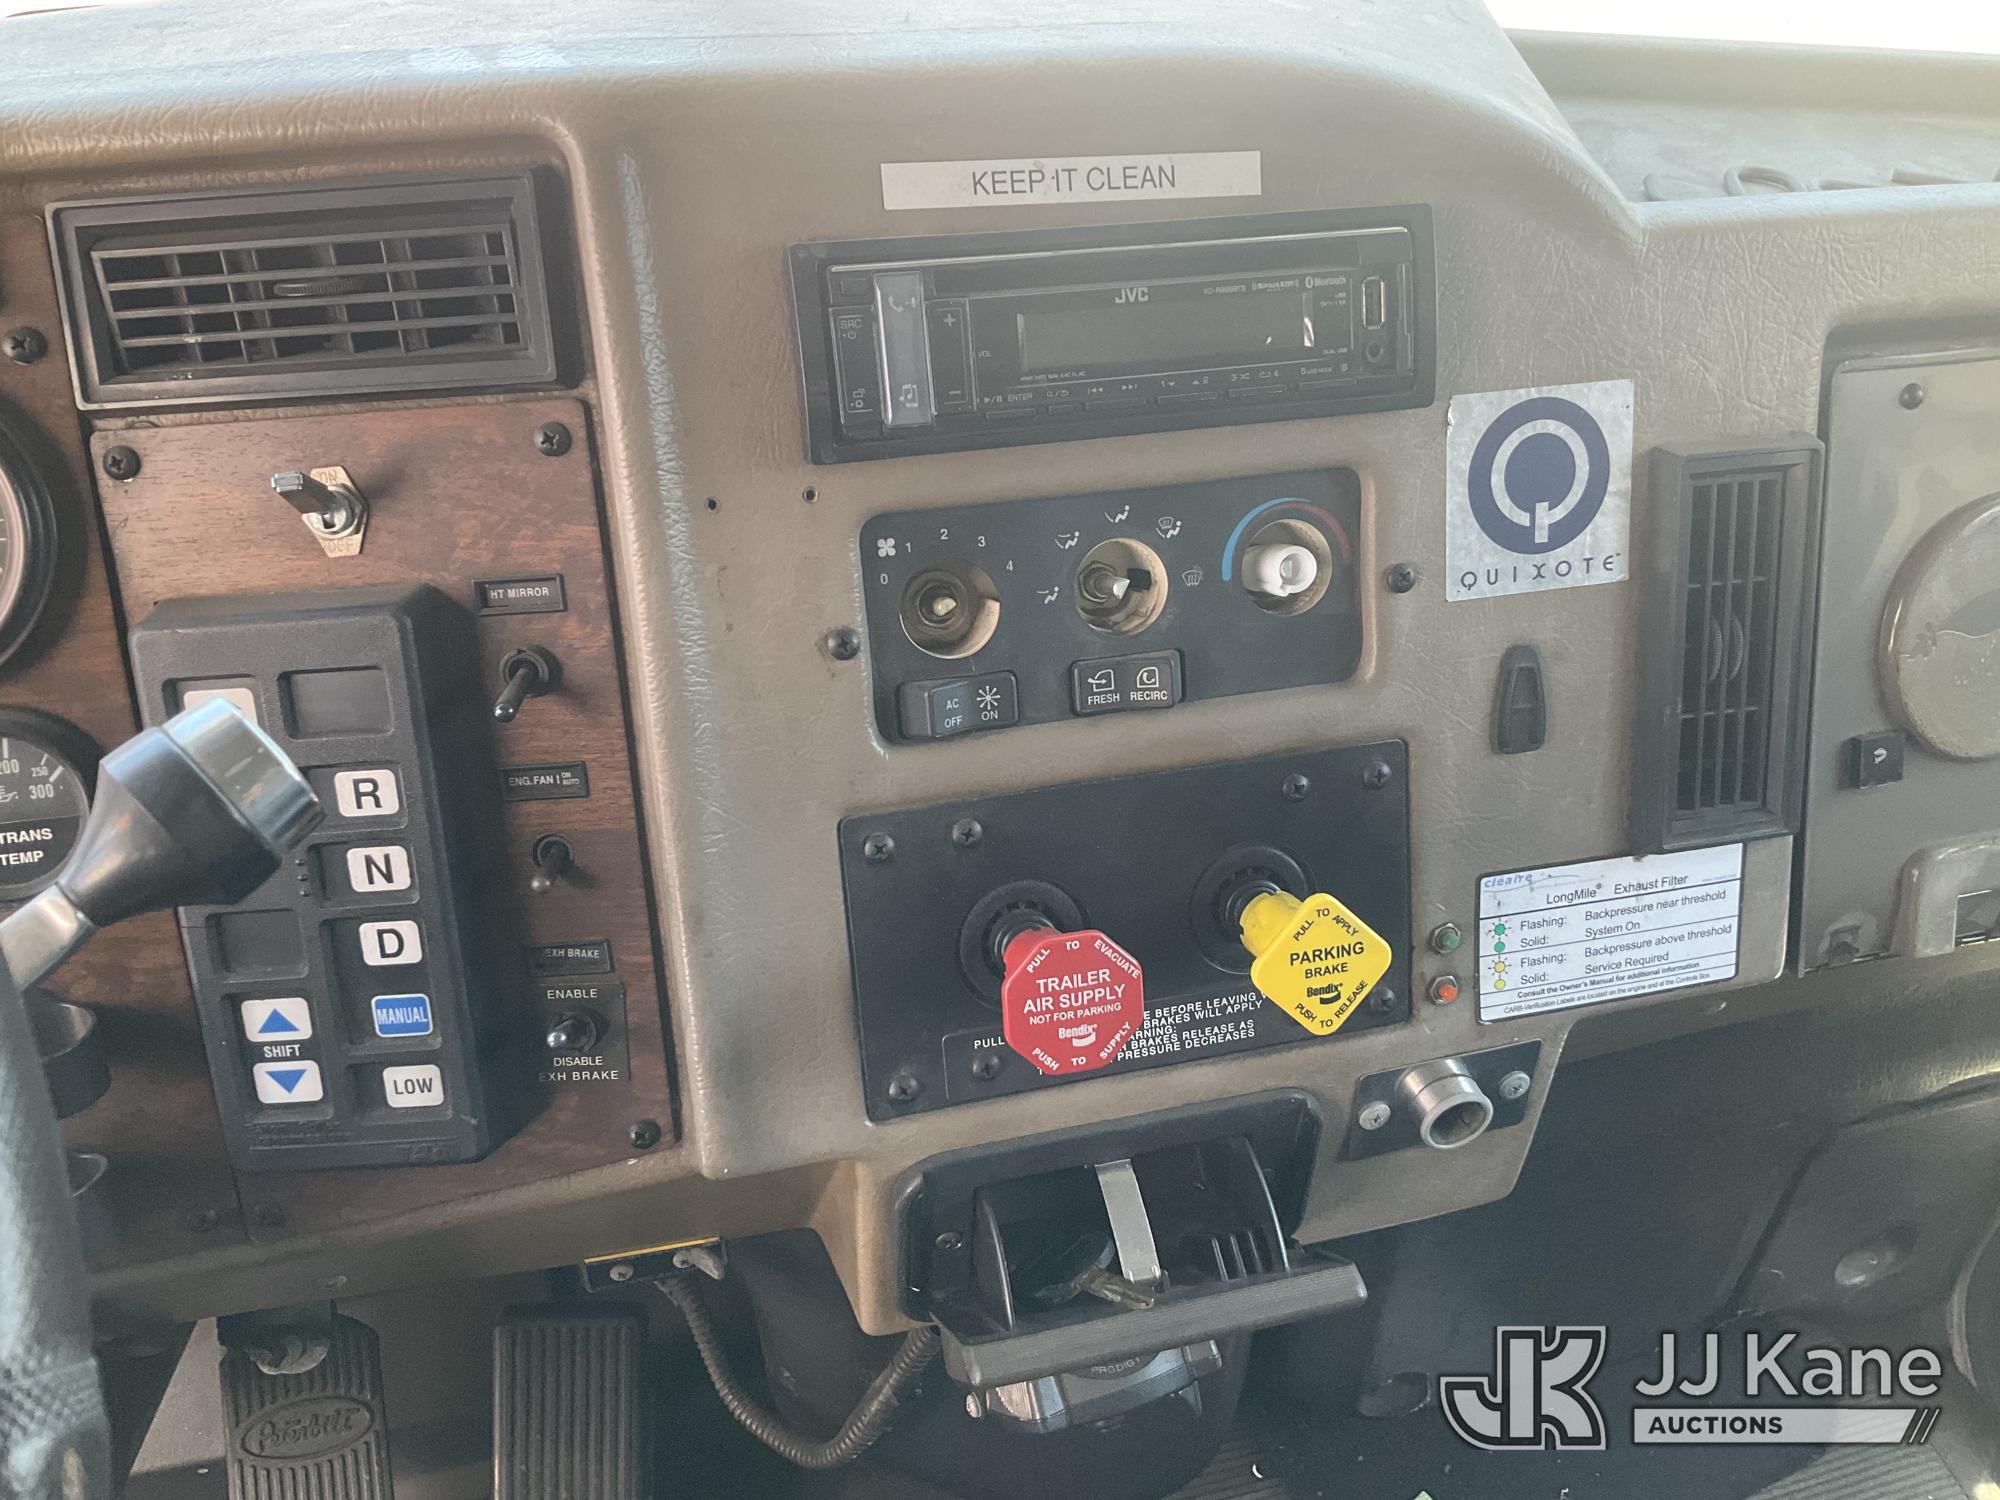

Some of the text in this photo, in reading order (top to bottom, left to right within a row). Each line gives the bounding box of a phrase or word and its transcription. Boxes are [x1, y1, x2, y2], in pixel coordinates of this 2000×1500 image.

[972, 165, 1177, 196] KEEP IT CLEAN
[1115, 287, 1149, 304] JVC
[840, 319, 862, 330] SRC
[939, 529, 949, 541] 2
[977, 536, 986, 548] 3
[905, 542, 912, 553] 1
[1006, 560, 1014, 572] 4
[1460, 554, 1614, 591] QUIXOTE
[490, 587, 550, 600] HT MIRROR
[945, 698, 959, 710] AC
[1087, 692, 1120, 706] FRESH
[1130, 687, 1168, 702] RECIRC
[944, 715, 963, 728] OFF
[981, 709, 999, 721] ON
[31, 766, 48, 778] 250
[28, 784, 55, 800] 300
[352, 777, 383, 811] R
[0, 828, 53, 845] TRANS
[0, 850, 44, 866] TEMP
[363, 853, 395, 886] N
[1614, 879, 1659, 895] Exhaust
[1661, 875, 1689, 888] Filter
[1520, 889, 1726, 931] Flashing: Backpressure near threshold
[1293, 907, 1359, 942] PULL TO APPLY
[1520, 920, 1641, 948] Solid: System On
[377, 928, 406, 960] D
[567, 948, 600, 959] BRAKE
[1289, 940, 1365, 967] PARKING
[1520, 924, 1732, 968] Flashing: Backpressure above threshold
[1026, 939, 1140, 979] PULL TO EVACUATE
[1520, 951, 1669, 985] Solid: Service Required
[1304, 961, 1349, 979] BRAKE
[1035, 968, 1112, 995] TRAILER
[1306, 983, 1342, 998] Bendix
[1517, 987, 1546, 999] Consult
[1546, 986, 1558, 995] the
[1559, 981, 1588, 993] Owner's
[1589, 975, 1615, 987] Manual
[1615, 973, 1626, 982] for
[1627, 967, 1661, 980] additional
[547, 988, 598, 1000] ENABLE
[1023, 983, 1126, 1014] AIR SUPPLY
[1294, 979, 1368, 1029] PUSH TO RELEASE
[376, 1006, 429, 1026] MANUAL
[974, 1036, 1006, 1050] PULL
[1155, 1001, 1203, 1019] BEFORE
[1206, 991, 1257, 1010] LEAVING
[1029, 1002, 1122, 1025] NOT FOR PARKING
[1143, 1013, 1191, 1030] BRAKES
[1194, 1006, 1222, 1020] WILL
[1226, 999, 1263, 1015] APPLY
[1058, 1024, 1095, 1040] Bendix
[1131, 1033, 1179, 1051] BRAKES
[1182, 1022, 1235, 1041] RELEASE
[1239, 1019, 1254, 1030] AS
[263, 1043, 301, 1059] SHIFT
[1032, 1047, 1060, 1071] PUSH
[1071, 1056, 1087, 1067] TO
[1099, 1021, 1131, 1060] SUPPLY
[1117, 1041, 1181, 1062] PRESSURE
[1185, 1028, 1256, 1050] DECREASES
[553, 1055, 604, 1067] DISABLE
[572, 1070, 619, 1081] BRAKE
[393, 1076, 433, 1096] LOW
